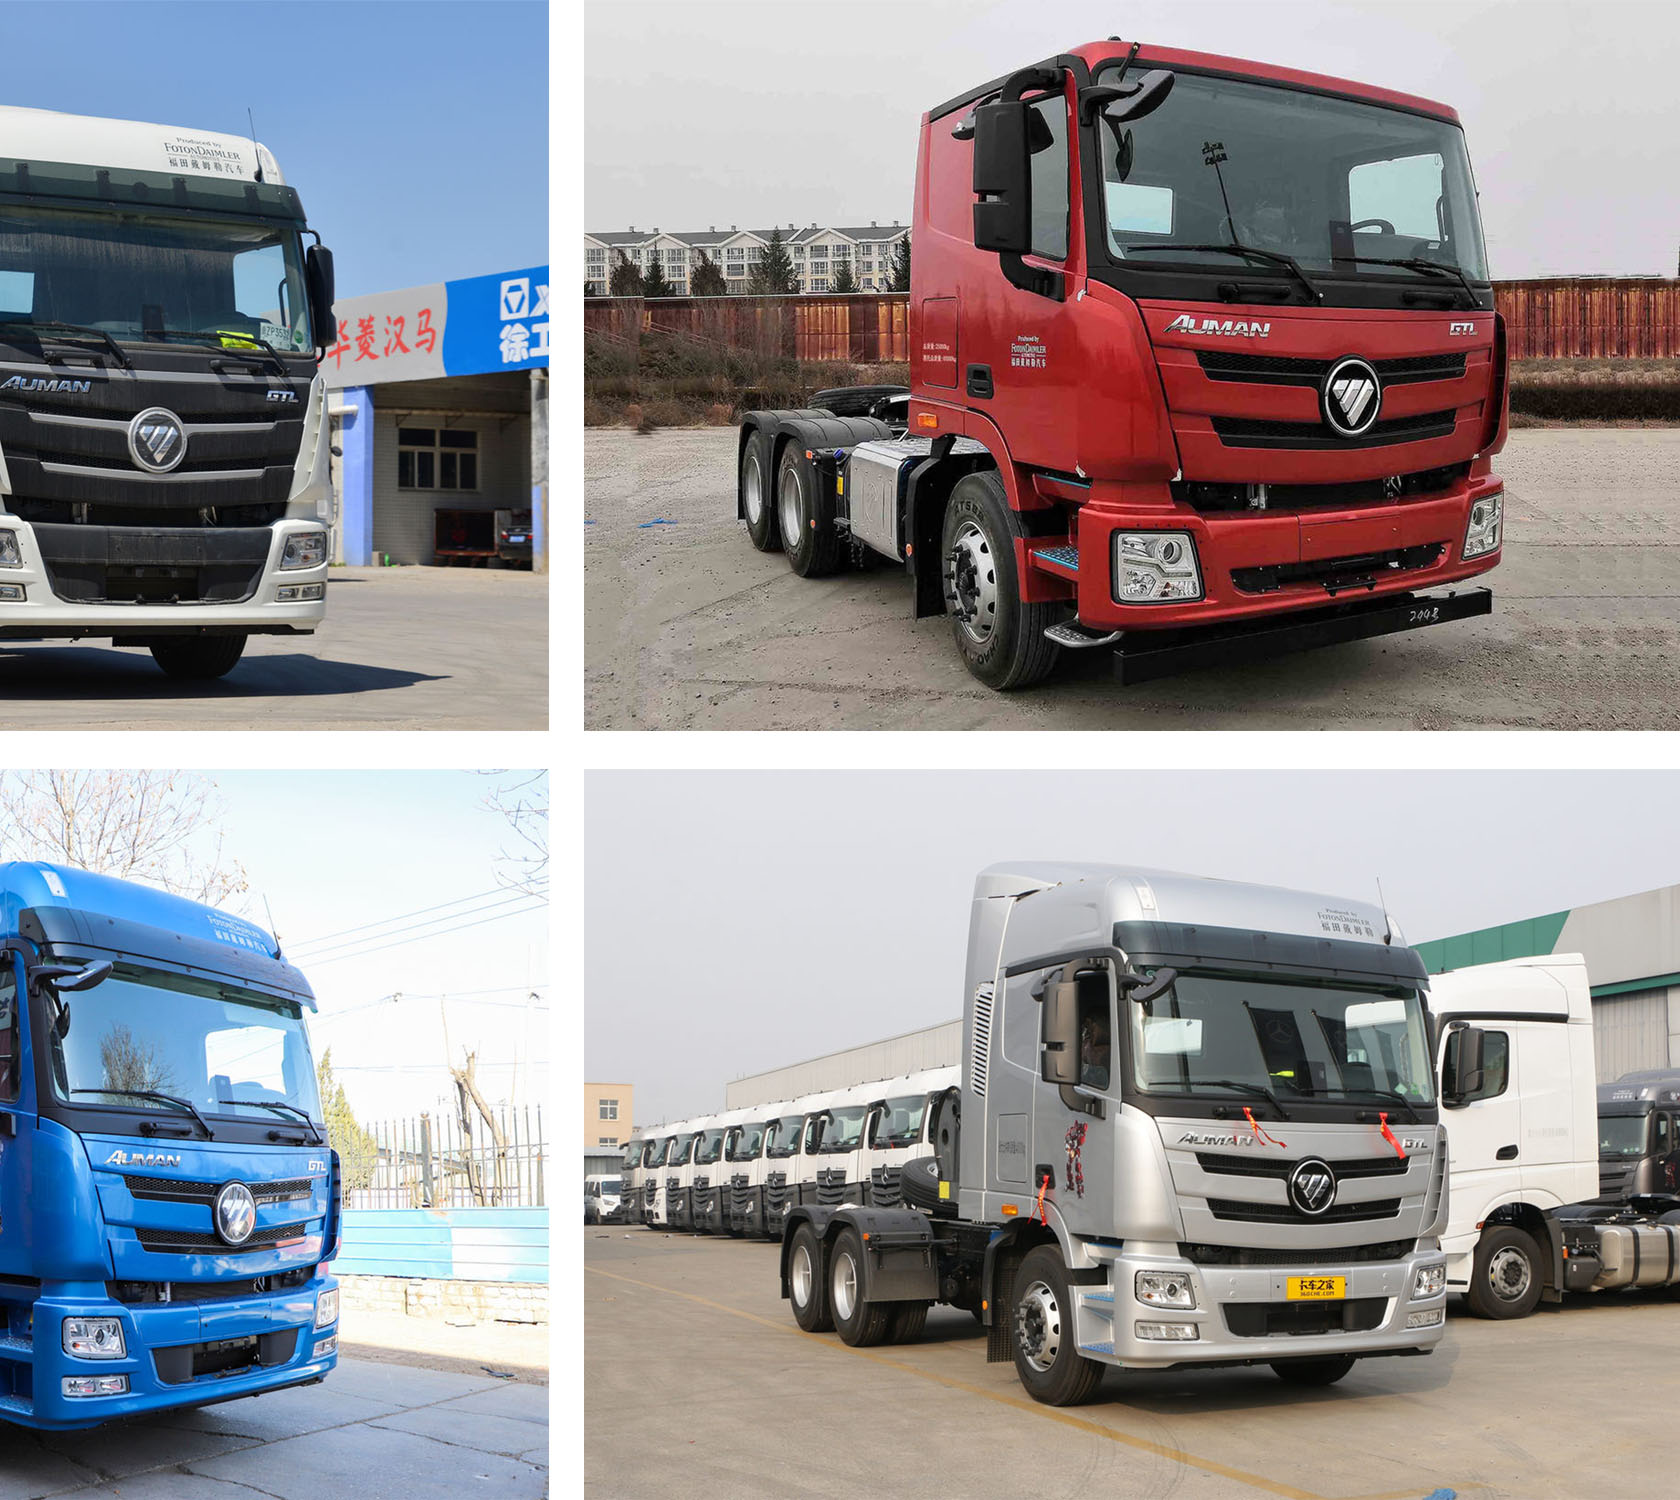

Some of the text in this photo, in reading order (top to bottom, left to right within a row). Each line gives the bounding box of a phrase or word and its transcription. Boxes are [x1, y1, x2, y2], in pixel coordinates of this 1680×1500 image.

[176, 137, 211, 146] Produced
[169, 157, 244, 175] 福田戴姆勒汽车
[1163, 315, 1479, 337] AUMAN GTL
[0, 375, 300, 403] AUMAN GTL
[1177, 1131, 1428, 1149] AUMAN GTL
[105, 1150, 327, 1171] AUMAN GTL
[1299, 1279, 1335, 1290] 卡车之家
